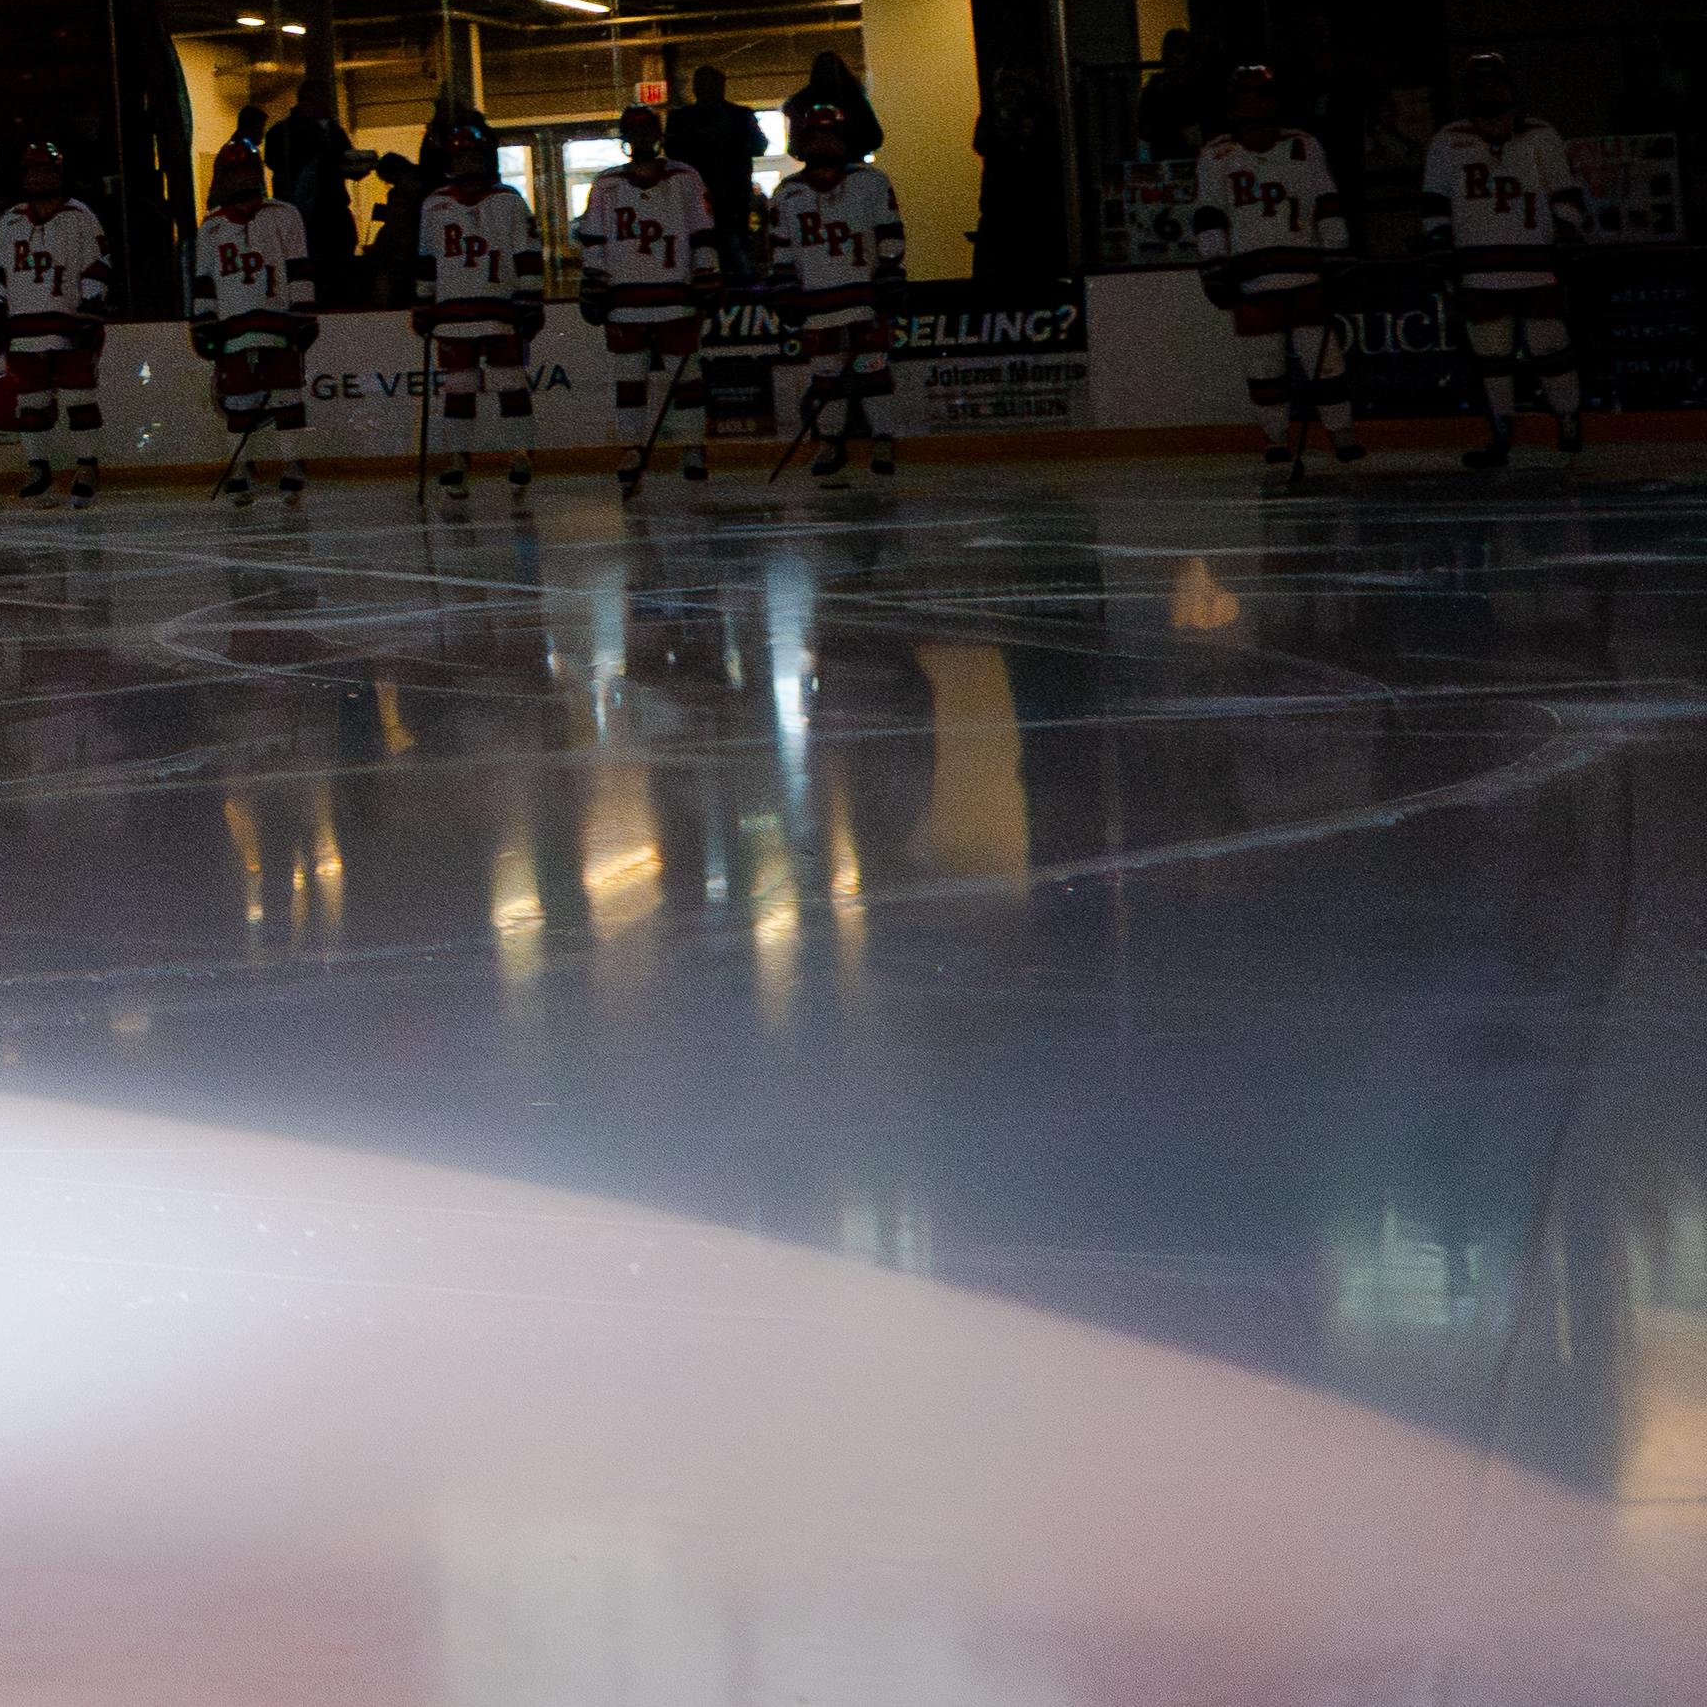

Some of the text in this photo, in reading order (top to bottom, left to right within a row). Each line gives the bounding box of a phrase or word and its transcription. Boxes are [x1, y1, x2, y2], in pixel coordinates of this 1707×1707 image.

[1229, 170, 1301, 232] RPI
[1462, 162, 1537, 230] RPI
[443, 223, 502, 284] RPI
[615, 206, 678, 269] RPI
[797, 212, 868, 267] RPI
[13, 240, 66, 297] RPI
[218, 242, 278, 298] RPI
[891, 303, 1080, 349] SELLING?
[312, 373, 364, 400] GE
